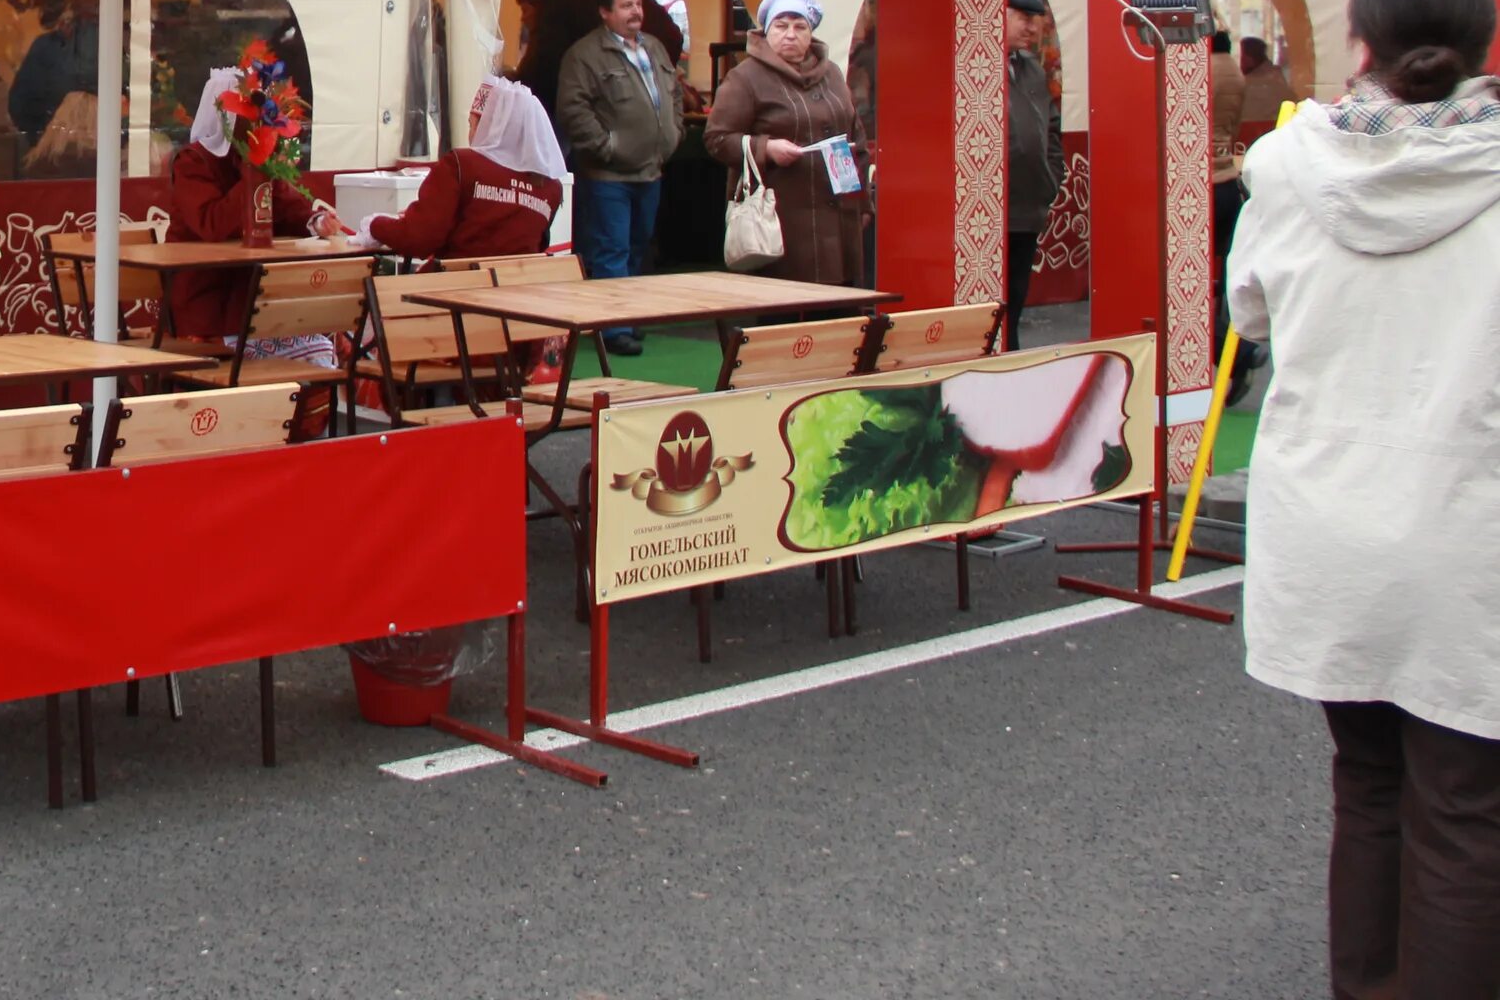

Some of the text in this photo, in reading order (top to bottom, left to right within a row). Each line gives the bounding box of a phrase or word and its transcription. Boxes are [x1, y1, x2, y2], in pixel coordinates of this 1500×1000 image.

[510, 178, 533, 192] ОАО
[629, 524, 737, 562] ГОМЕЛЬСКИЙ
[614, 547, 750, 588] МЯСОКОМБИНАТ
